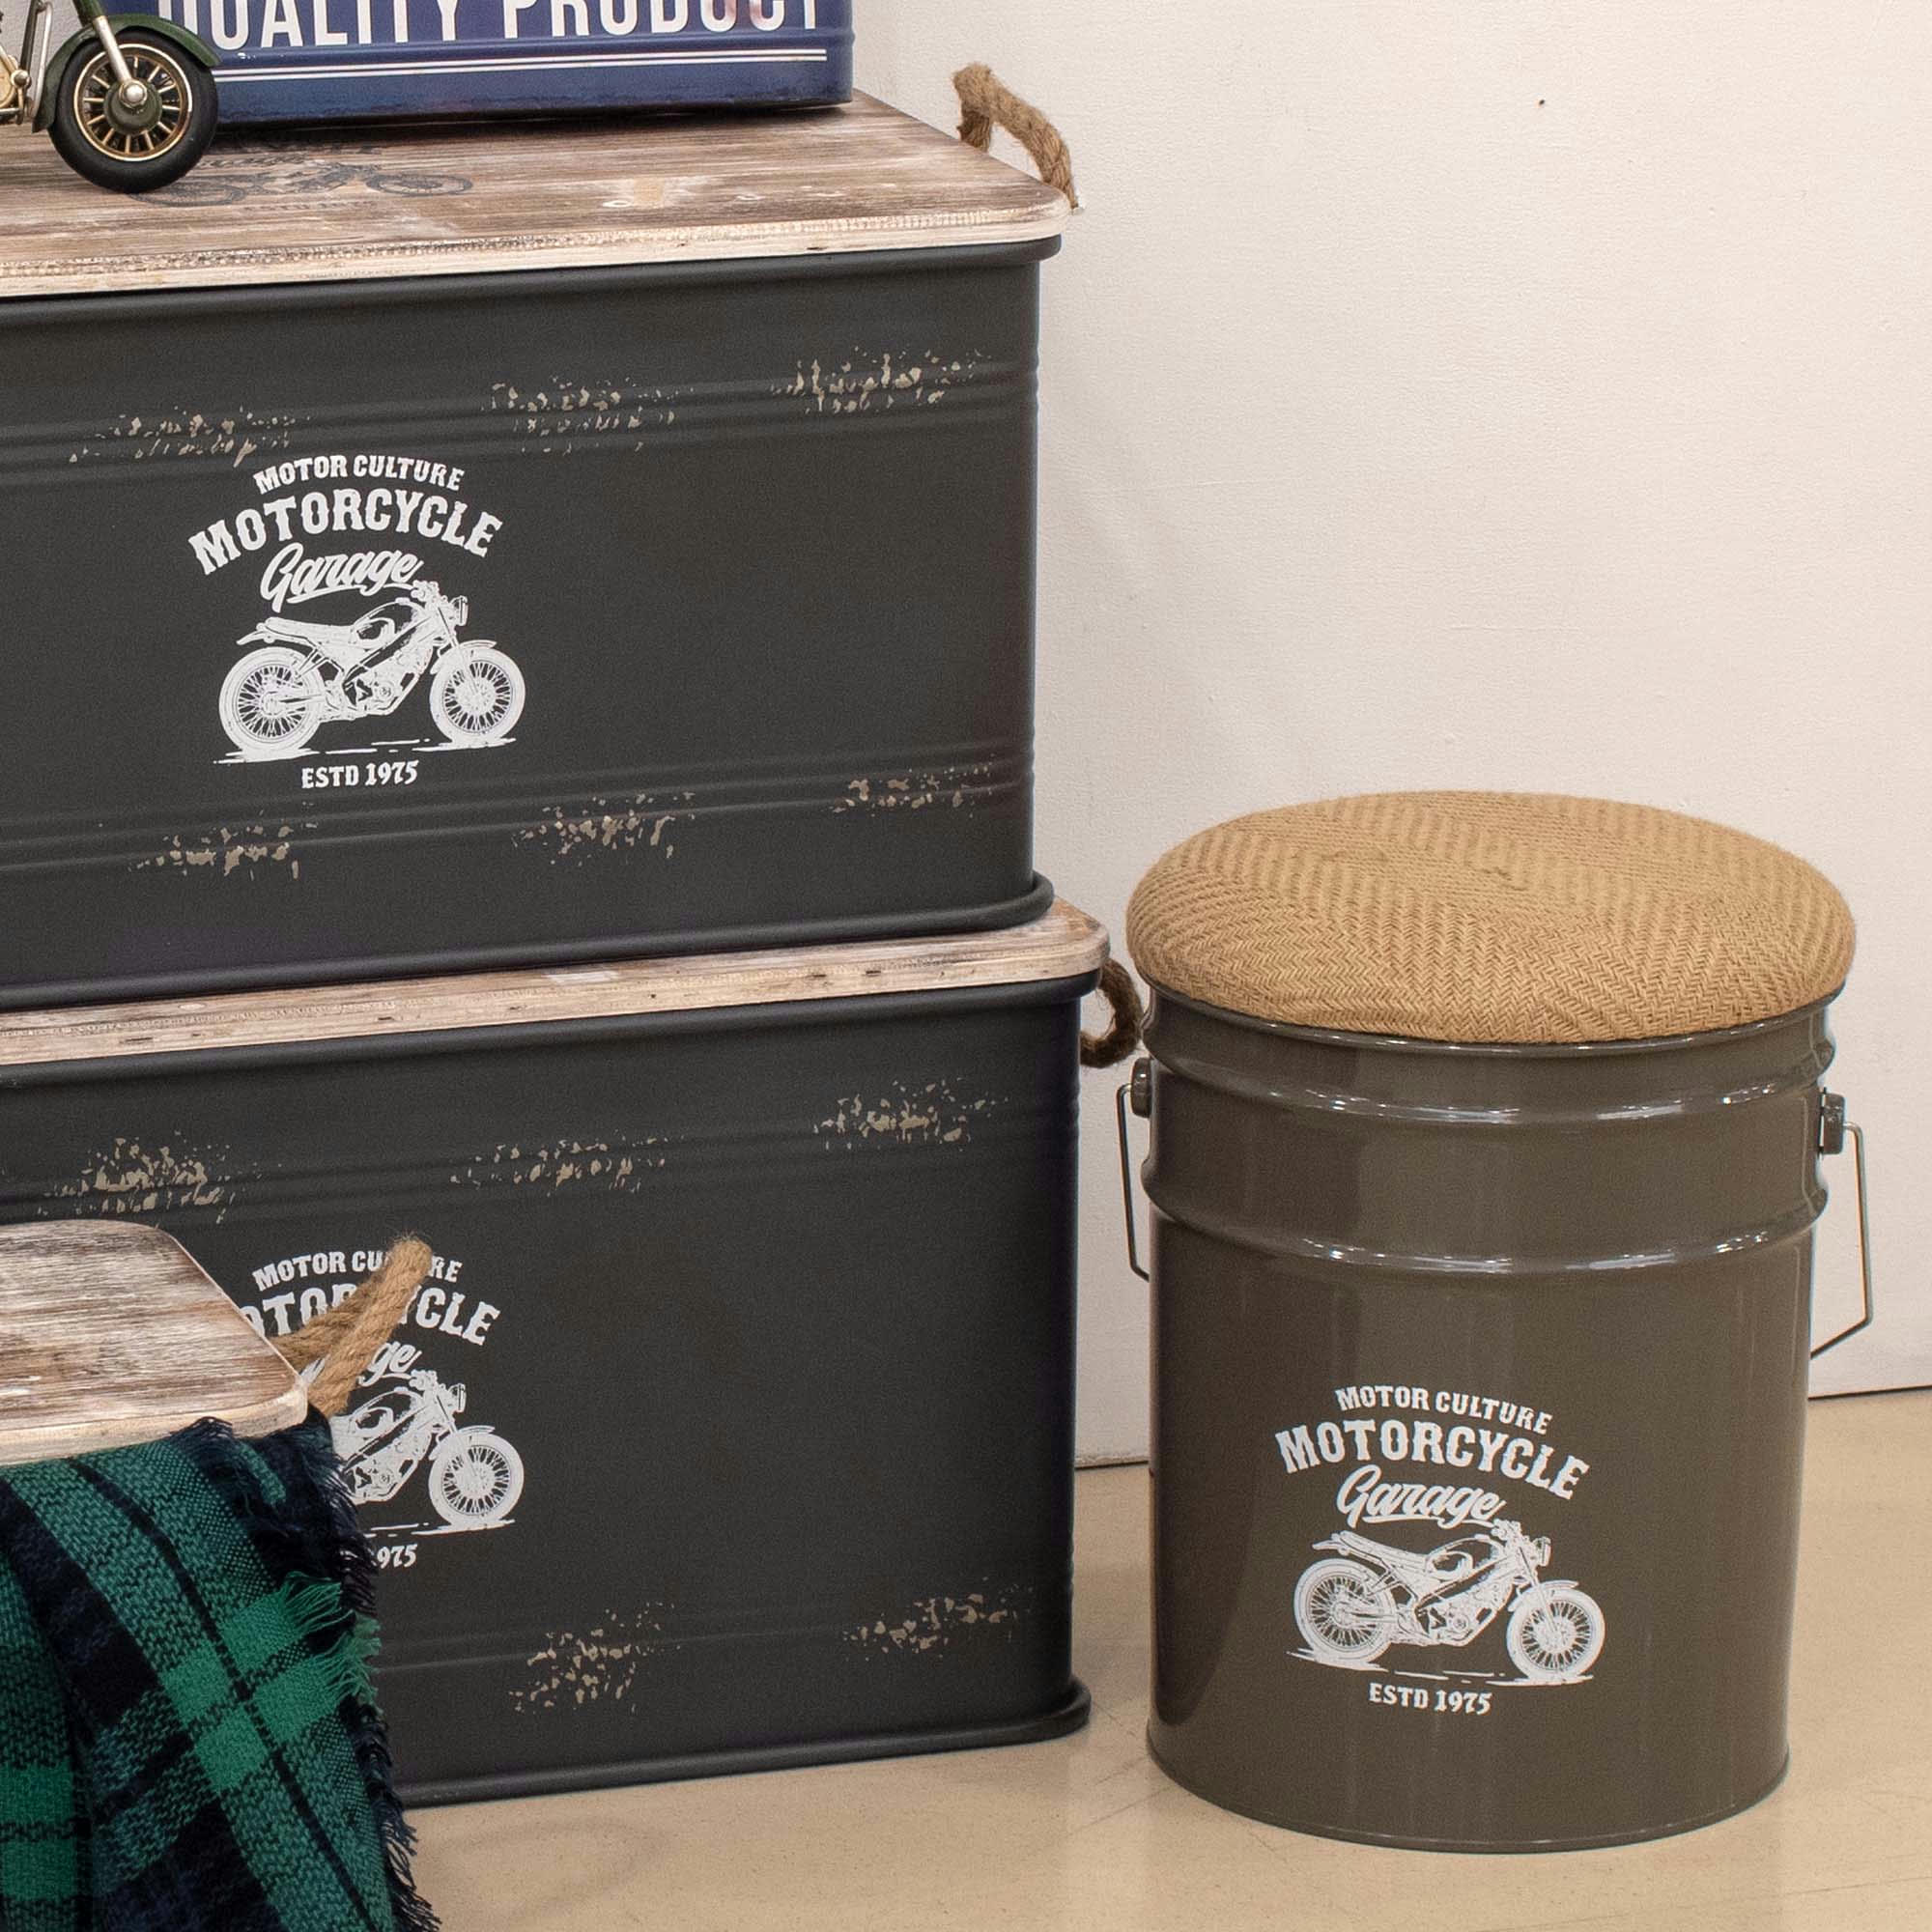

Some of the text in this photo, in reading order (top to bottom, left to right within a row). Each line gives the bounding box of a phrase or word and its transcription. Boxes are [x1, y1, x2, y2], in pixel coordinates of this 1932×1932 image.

[158, 0, 458, 50] UALITY
[252, 454, 466, 496] MOTOR CULTURE
[188, 488, 503, 576] MOTORCYCLE
[260, 542, 424, 612] Garage
[301, 759, 420, 788] ESTD 1975
[252, 1250, 463, 1292] MOTOR CURE
[1334, 1384, 1553, 1435] MOTOR CULTURE
[1275, 1419, 1590, 1500] MOTORCYCLE
[1336, 1464, 1507, 1529] Garage
[371, 1543, 418, 1570] 975
[1369, 1683, 1492, 1716] ESTD 1975
